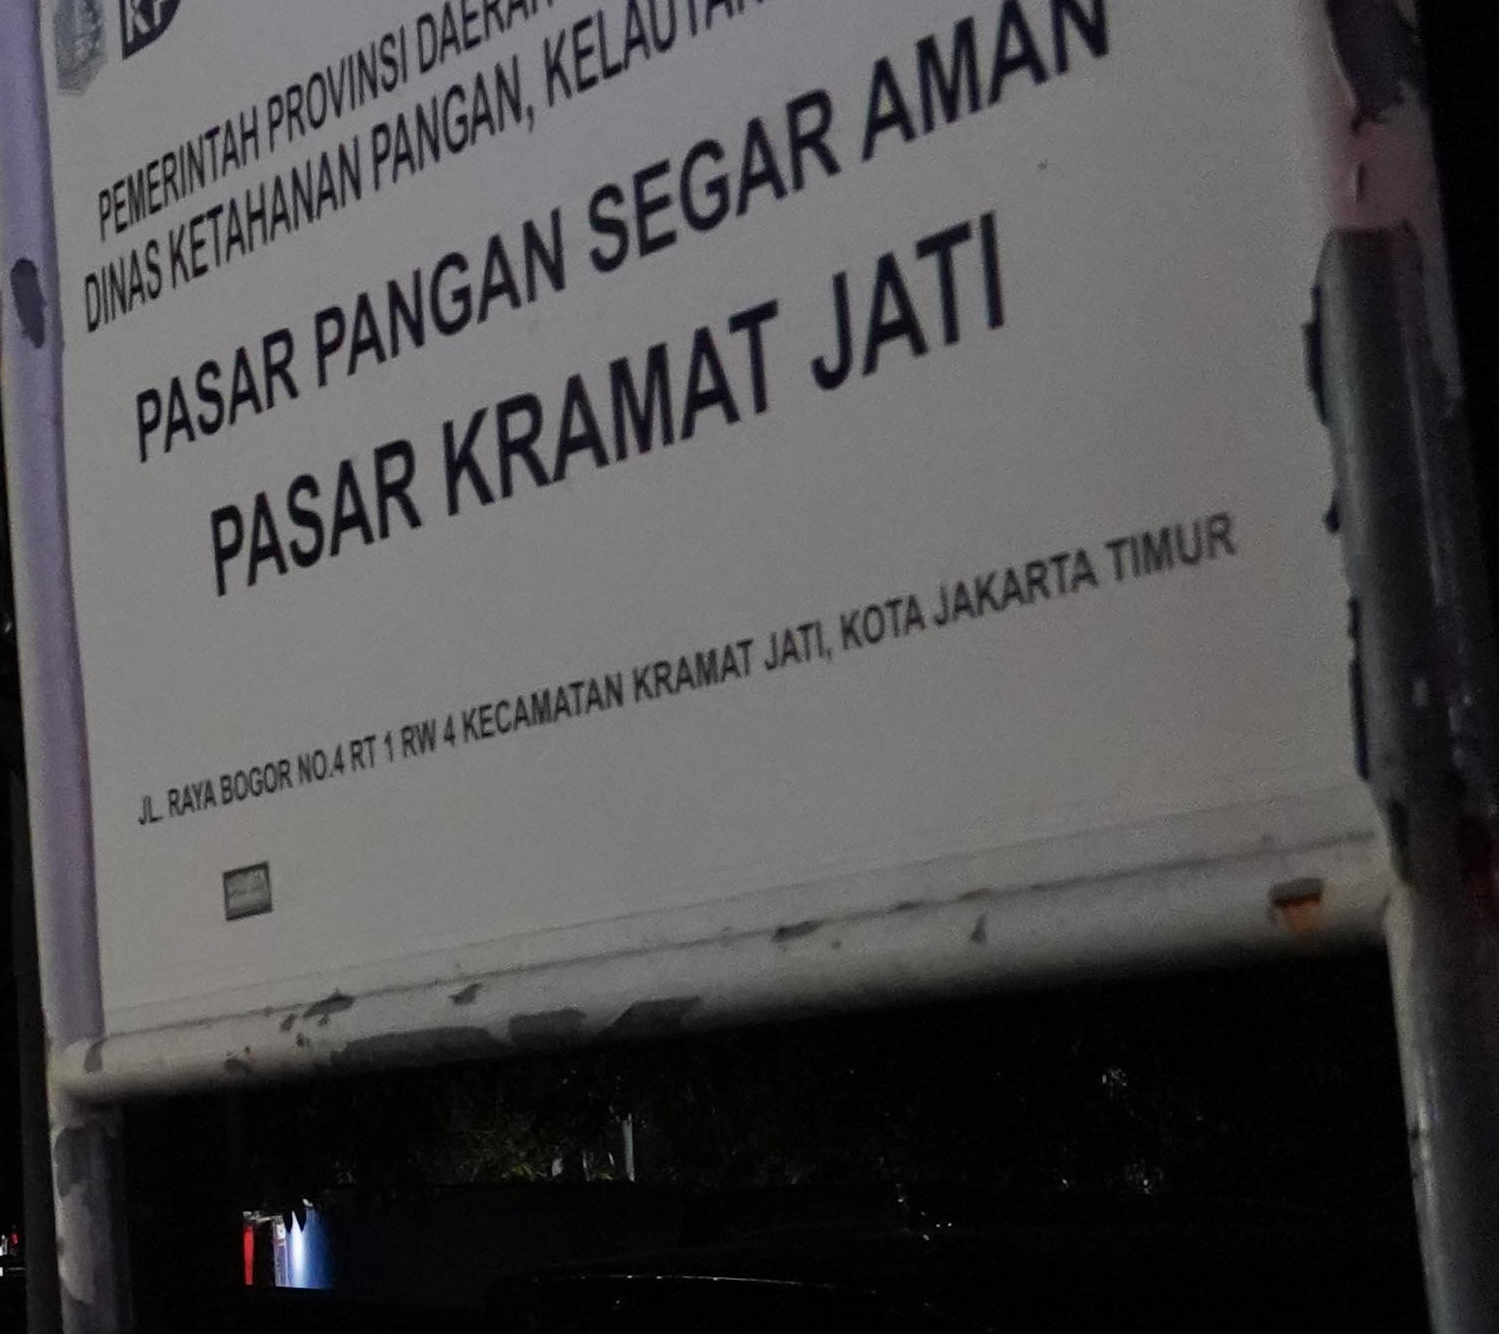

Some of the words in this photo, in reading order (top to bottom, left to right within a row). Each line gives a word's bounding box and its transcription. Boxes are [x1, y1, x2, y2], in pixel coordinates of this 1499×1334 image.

[84, 238, 163, 333] DINAS
[169, 135, 364, 295] KETAHANAN
[372, 54, 533, 192] PANGAN,
[99, 105, 259, 242] PEMERINTAH
[269, 25, 408, 153] PROVINSI
[136, 326, 299, 463] PASAR
[316, 208, 566, 388] PANGAN
[588, 89, 841, 273] SEGAR
[210, 440, 422, 597] PASAR
[443, 299, 780, 517] KRAMAT
[811, 210, 1006, 391] JATI
[168, 779, 216, 818] RAYA
[221, 758, 293, 806] BOGOR
[350, 735, 378, 773] RT
[384, 731, 395, 765] 1
[401, 718, 437, 759] RW
[443, 714, 456, 747] 4
[462, 670, 625, 743] KECAMATAN
[632, 638, 755, 704] KRAMAT
[763, 622, 832, 671] JATI,
[839, 595, 926, 650] KOTA
[932, 548, 1099, 627] JAKARTA
[1105, 512, 1237, 584] TIMUR
